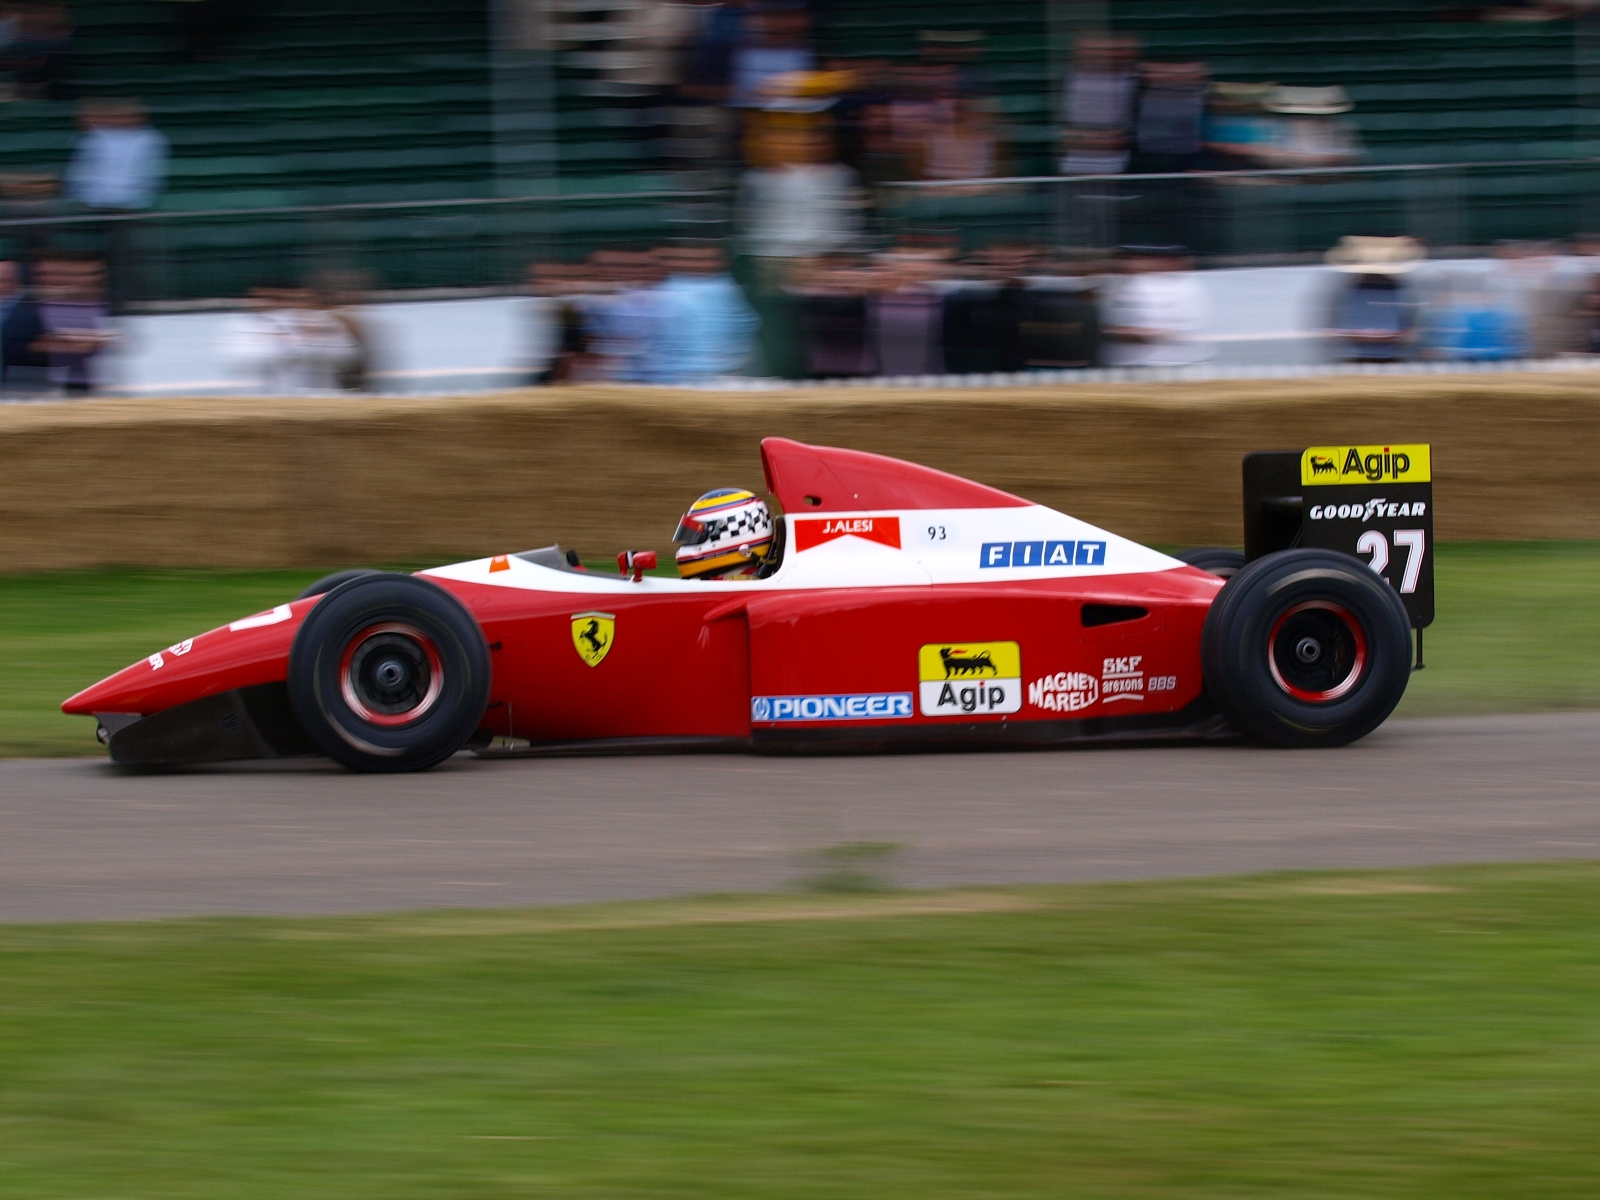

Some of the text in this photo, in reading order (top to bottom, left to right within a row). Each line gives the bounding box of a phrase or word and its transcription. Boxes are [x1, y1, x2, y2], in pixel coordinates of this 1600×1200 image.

[1342, 447, 1410, 480] Agip
[1310, 499, 1426, 522] GOODYEAR
[823, 519, 873, 534] J.ALESI
[928, 526, 947, 540] 93
[988, 543, 1100, 566] FIAT
[1357, 529, 1424, 593] 27
[1102, 655, 1143, 673] SKF
[1102, 678, 1143, 694] arexons
[1148, 676, 1177, 691] BBS
[773, 695, 910, 718] PIONEER
[937, 680, 1005, 712] Agip
